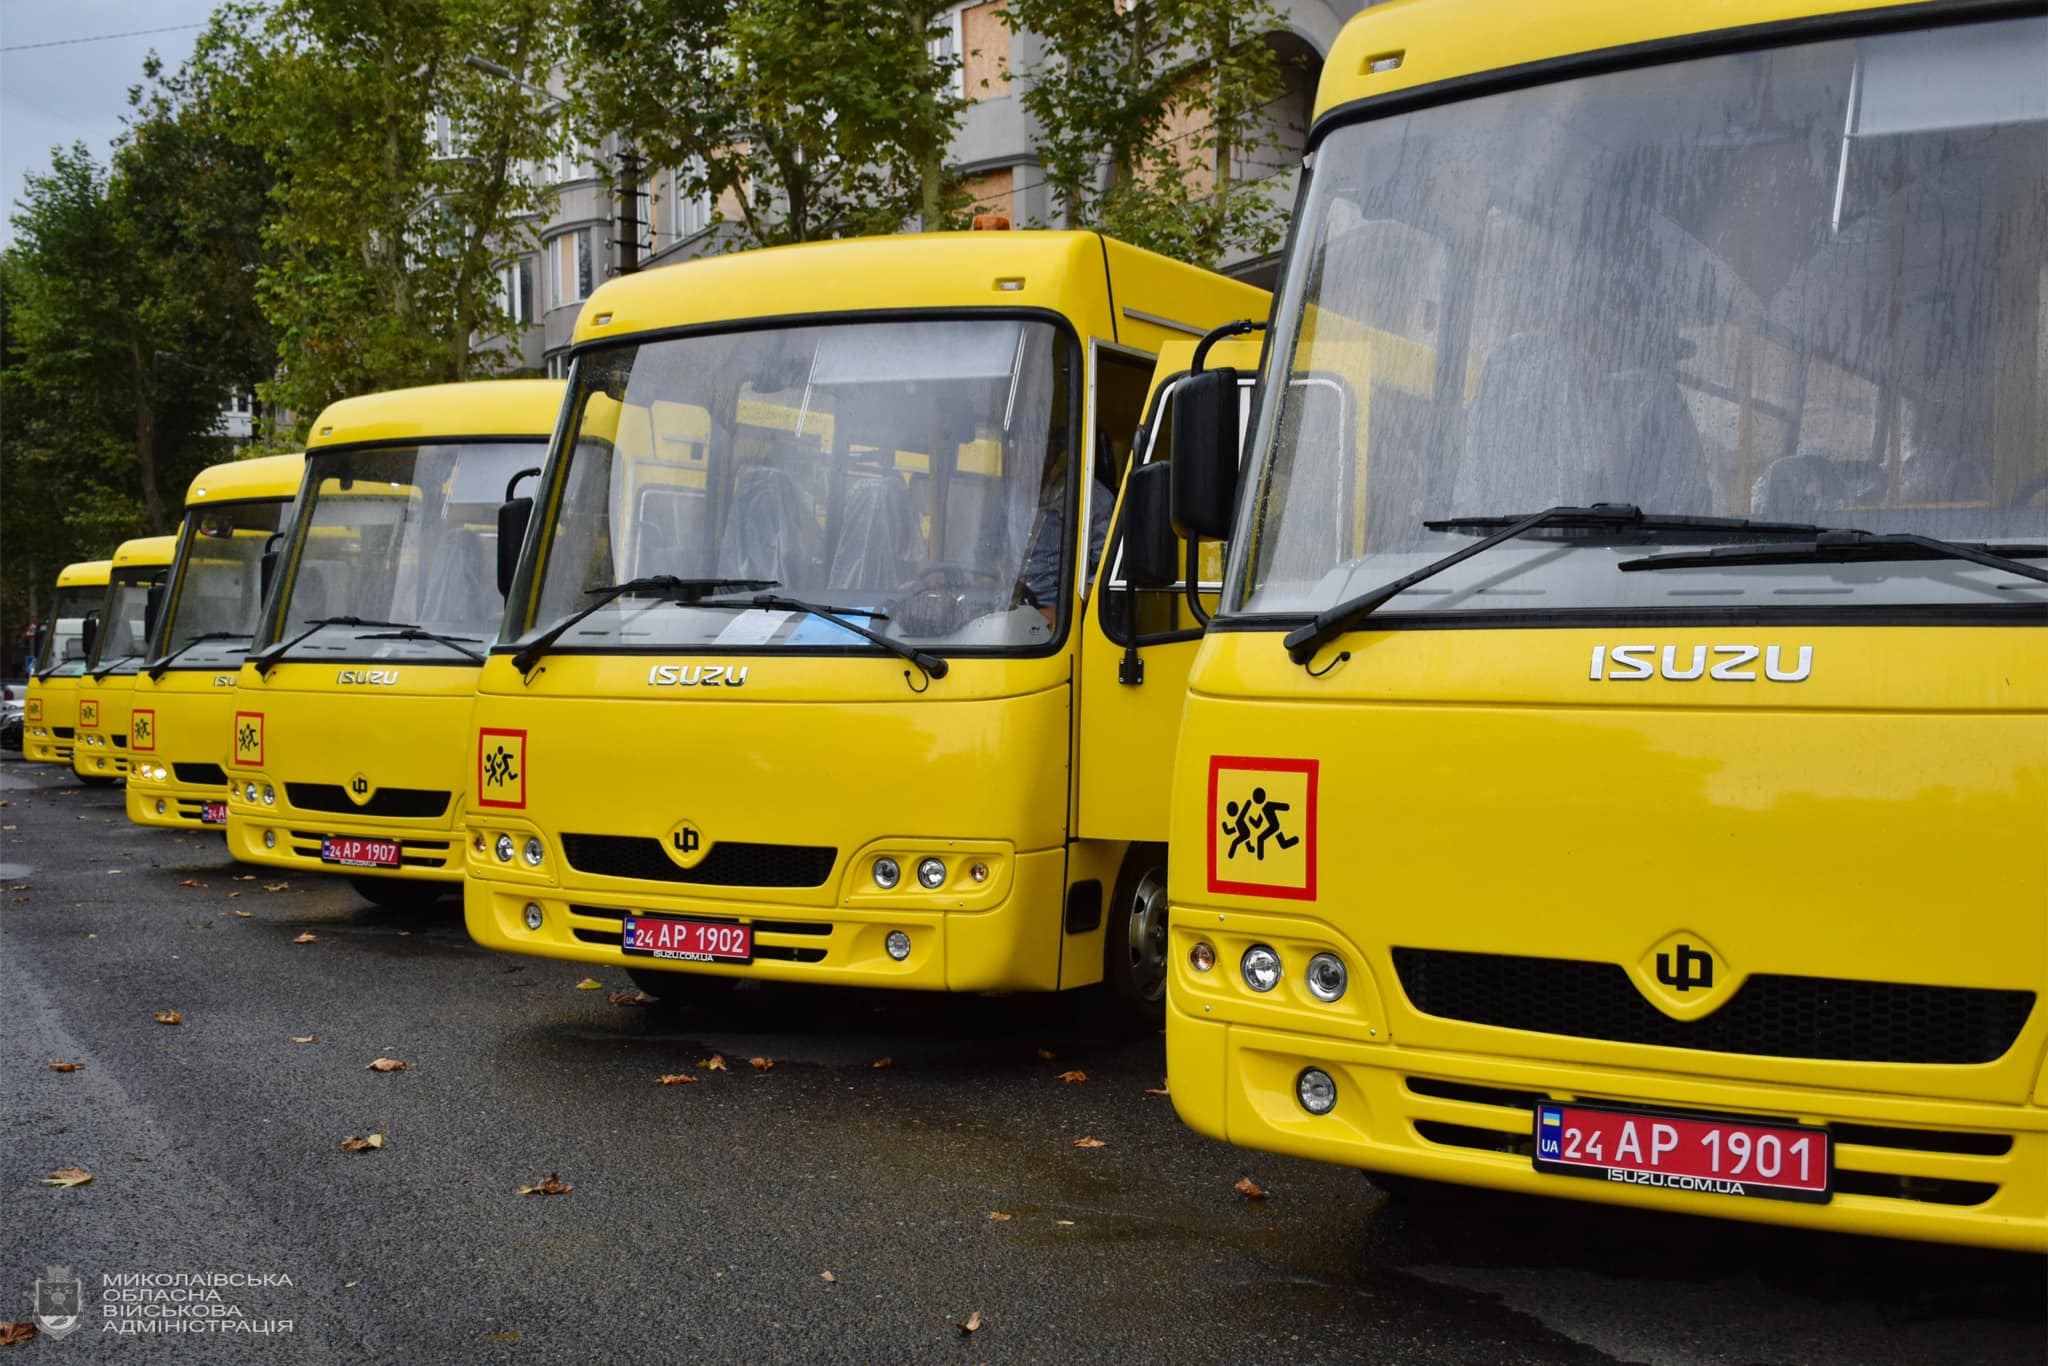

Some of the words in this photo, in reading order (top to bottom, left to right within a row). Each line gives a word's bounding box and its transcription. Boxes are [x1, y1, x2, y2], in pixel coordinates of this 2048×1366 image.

[1589, 645, 1814, 681] ISUZU
[214, 676, 239, 686] ISU
[336, 671, 399, 685] ISUZU
[648, 665, 748, 686] ISUZU
[329, 845, 341, 858] 24
[343, 841, 361, 858] AP
[366, 843, 396, 861] 1907
[626, 936, 634, 945] UA
[636, 929, 653, 947] 24
[658, 923, 687, 948] AP
[696, 926, 744, 953] 1902
[653, 950, 714, 962] ISUZU.COM.UA
[1541, 1139, 1559, 1153] UA
[1564, 1128, 1602, 1161] 24
[1614, 1120, 1679, 1165] AP
[1700, 1129, 1809, 1181] 1901
[1607, 1168, 1745, 1195] ISUZU.COM.UA
